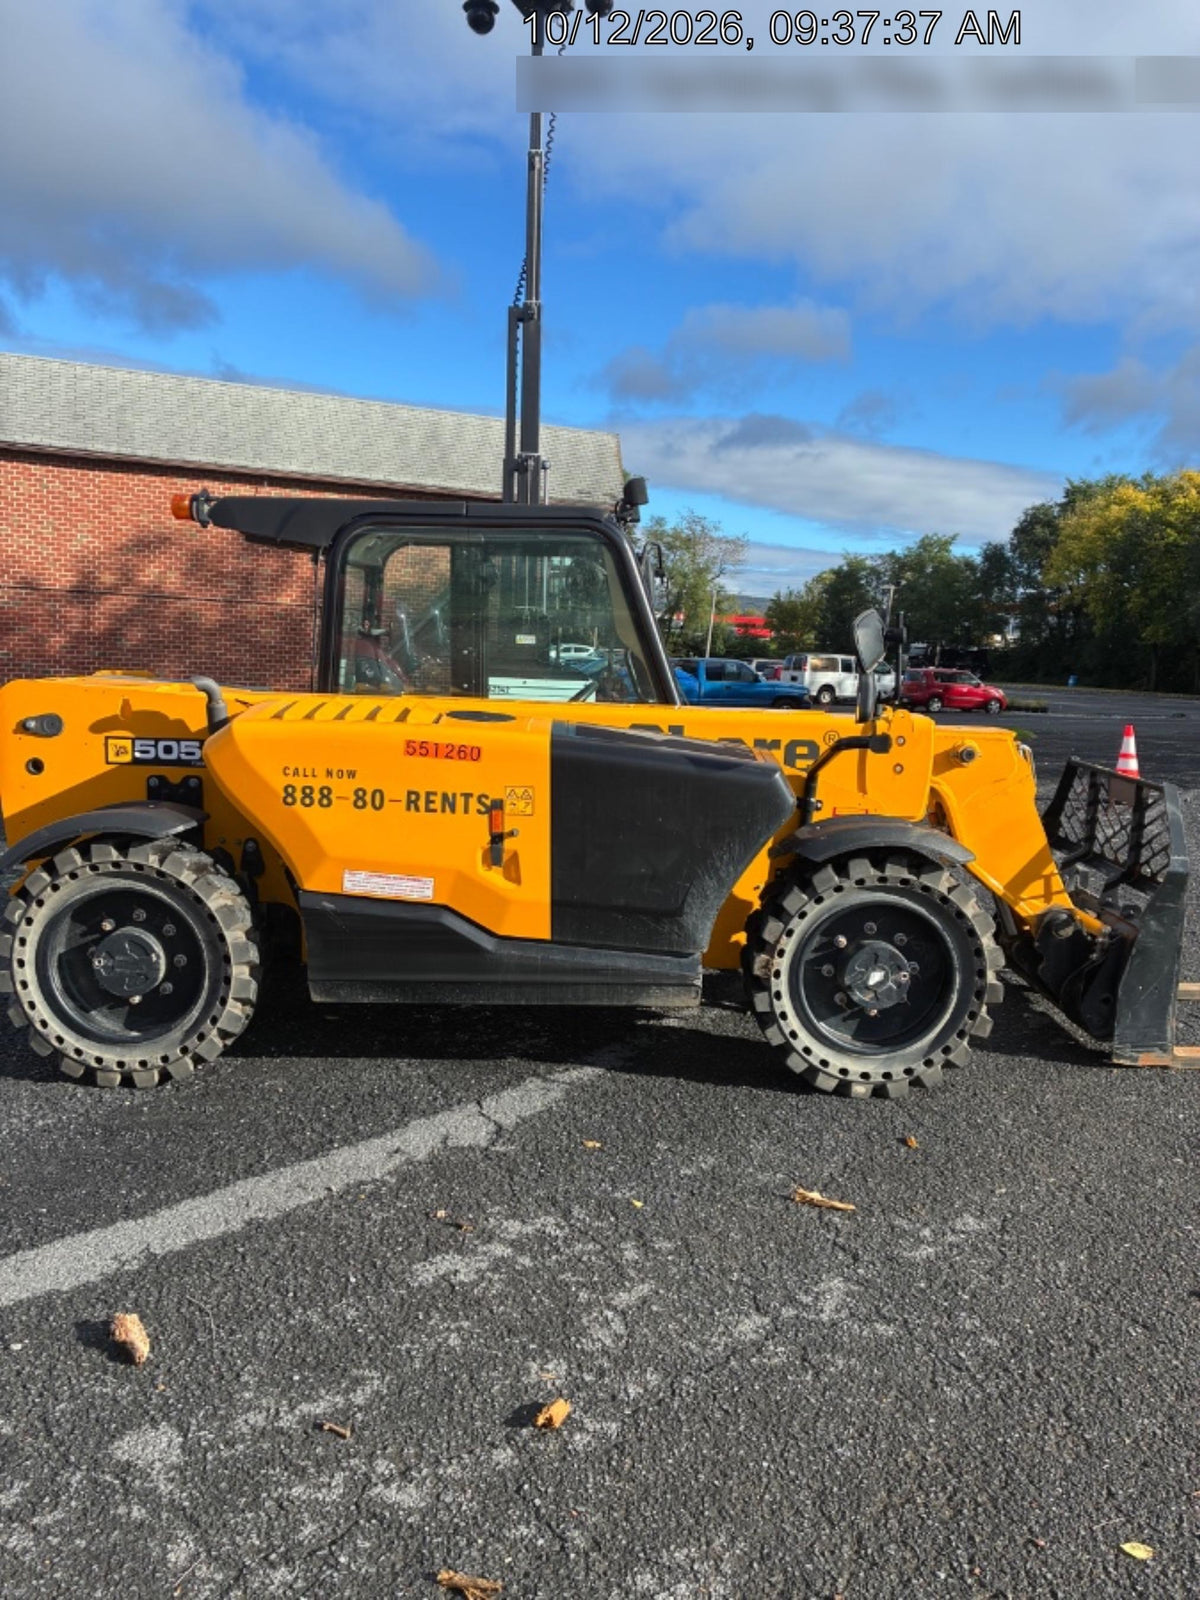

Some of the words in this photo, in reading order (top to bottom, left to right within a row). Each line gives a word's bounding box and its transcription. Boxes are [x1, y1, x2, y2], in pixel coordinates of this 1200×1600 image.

[134, 739, 202, 760] 505
[405, 740, 481, 761] 551260
[282, 766, 318, 778] CALL
[325, 768, 357, 779] NOW
